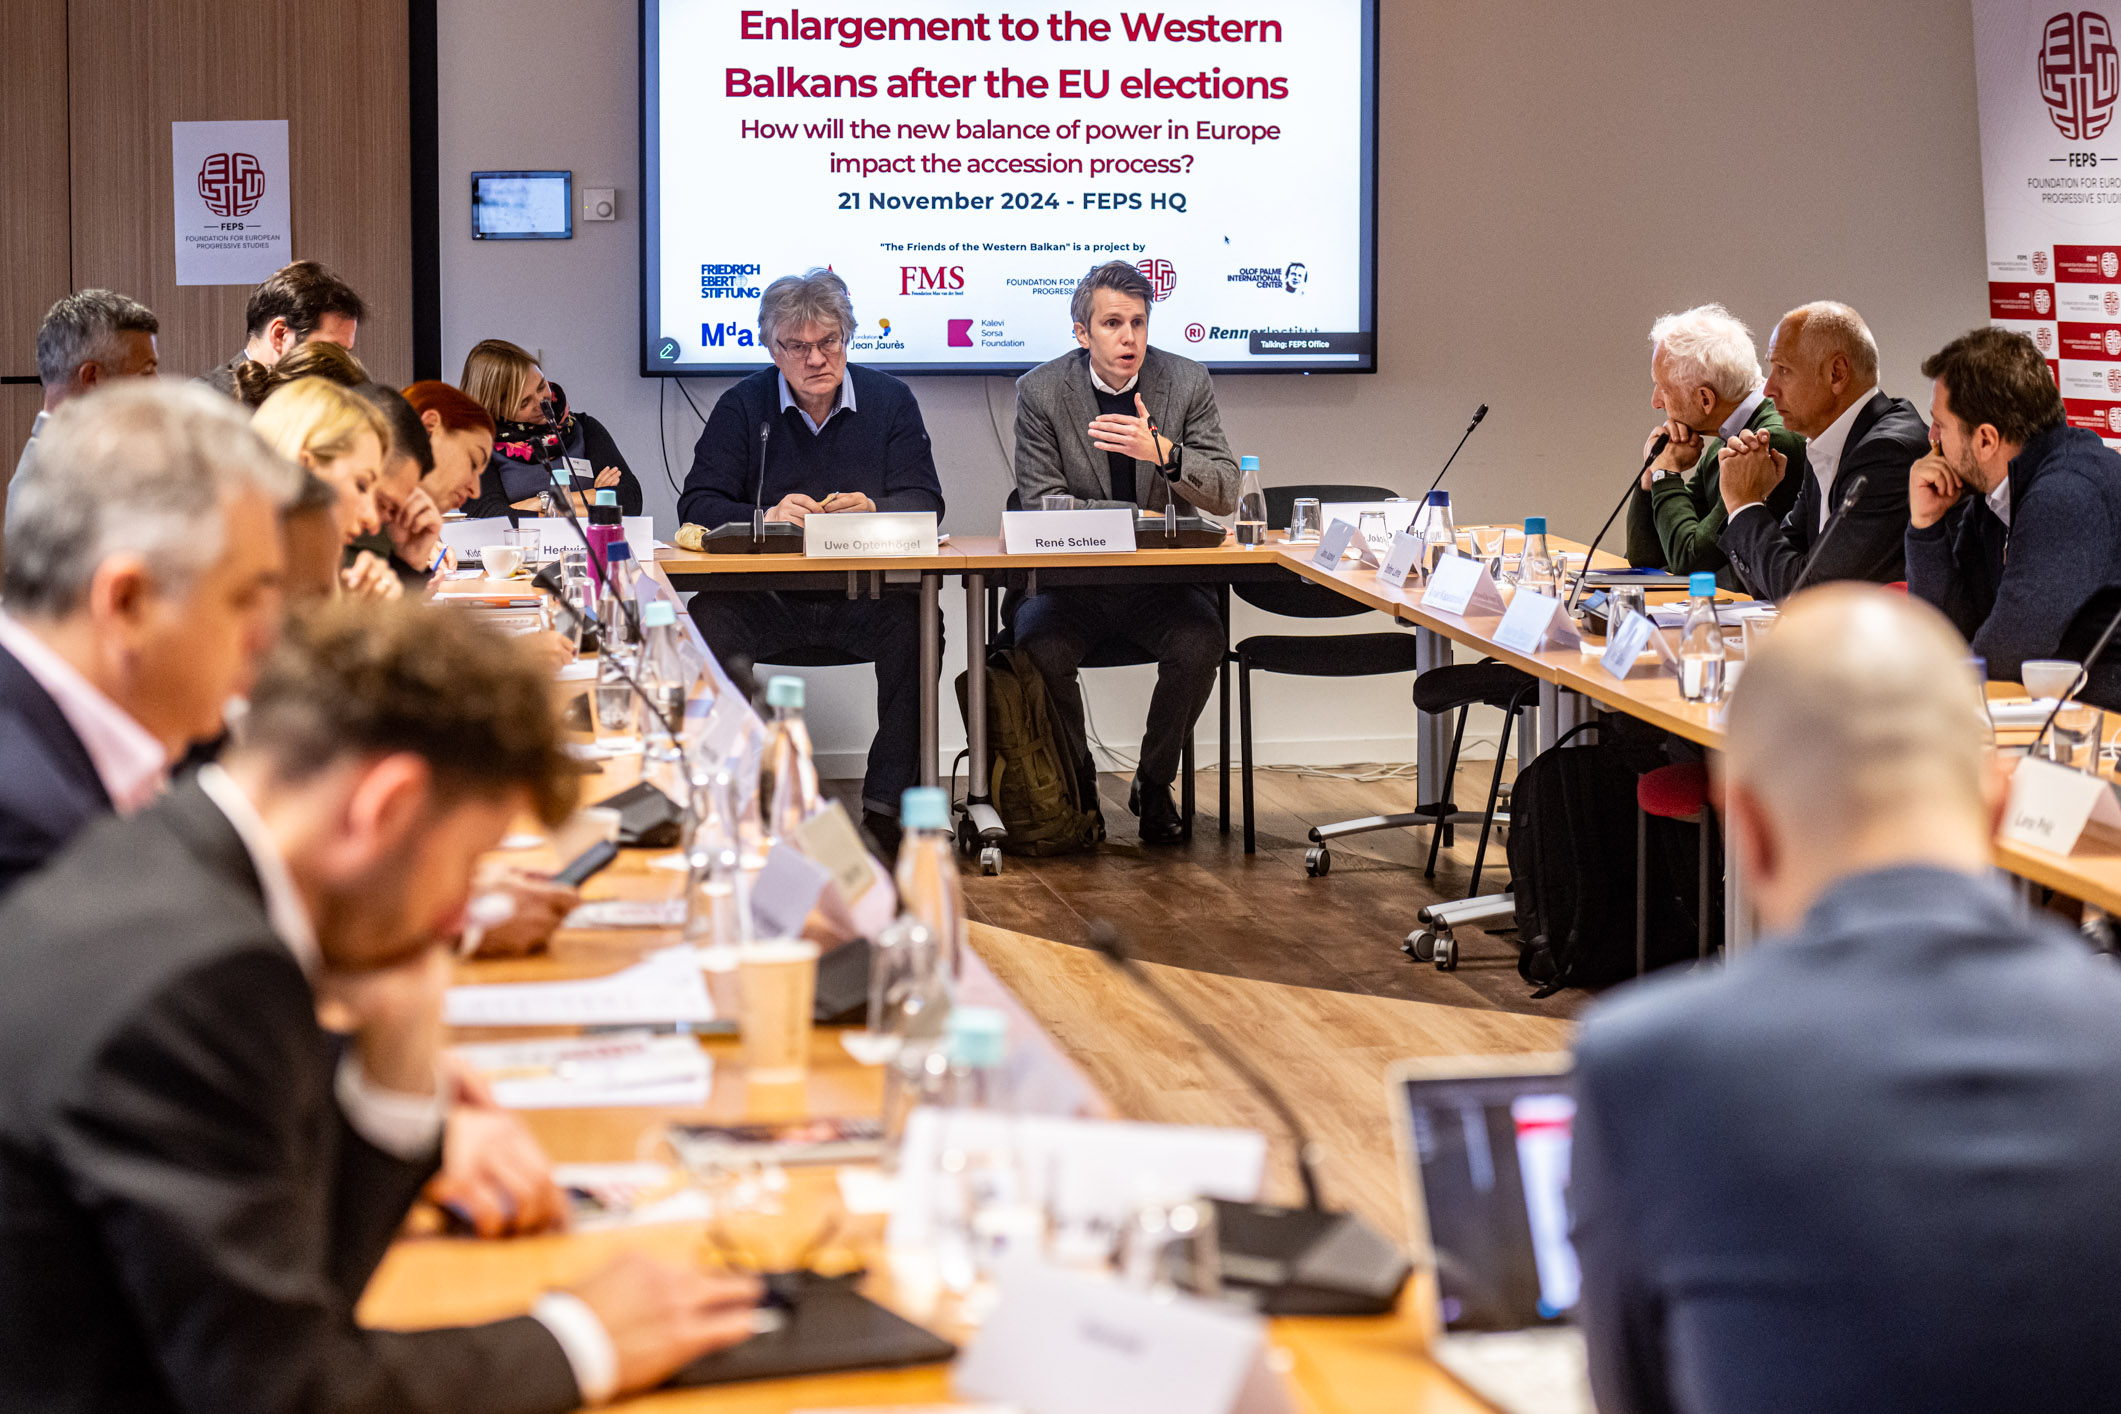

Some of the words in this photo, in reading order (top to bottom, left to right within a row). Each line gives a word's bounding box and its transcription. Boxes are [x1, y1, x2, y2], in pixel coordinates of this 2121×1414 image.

[741, 9, 991, 48] Enlargement
[999, 14, 1039, 41] to
[1047, 11, 1111, 41] the
[1120, 13, 1282, 42] Western
[725, 67, 878, 98] Balkans
[887, 67, 977, 98] after
[984, 67, 1049, 98] the
[1059, 69, 1110, 98] EU
[1120, 67, 1289, 99] elections
[741, 119, 799, 139] How
[803, 118, 844, 139] will
[850, 119, 891, 139] the
[898, 124, 950, 139] new
[956, 119, 1050, 139] balance
[1056, 119, 1081, 139] of
[1086, 124, 1162, 144] power
[1168, 119, 1189, 139] in
[1196, 121, 1281, 145] Europe
[830, 152, 916, 178] impact
[921, 153, 962, 173] the
[967, 152, 1083, 173] accession
[1090, 154, 1194, 178] process?
[2069, 153, 2097, 167] FEPS
[2027, 177, 2079, 189] FOUNDATION
[2081, 177, 2097, 189] FOR
[2100, 177, 2121, 189] EURO
[838, 193, 860, 209] 21
[869, 192, 994, 209] November
[1001, 193, 1059, 209] 2024
[1083, 193, 1142, 209] FEPS
[1150, 193, 1187, 213] HQ
[2042, 193, 2094, 204] PROGRESSIVE
[2097, 193, 2121, 204] STUDI
[220, 223, 244, 231] FEPS
[880, 243, 904, 251] "The
[907, 243, 947, 251] Friends
[949, 243, 960, 251] of
[962, 243, 980, 251] the
[983, 243, 1027, 251] Western
[1030, 243, 1071, 251] Balkan"
[1073, 243, 1082, 251] is
[1093, 243, 1130, 253] project
[1133, 243, 1146, 253] by
[701, 264, 761, 275] FRIEDRICH
[701, 276, 735, 286] EBERT
[899, 265, 965, 296] FMS
[1227, 274, 1282, 282] INTERNATIONAL
[1256, 281, 1283, 289] CENTER
[701, 287, 761, 299] STIFTUNG
[1032, 287, 1077, 295] PROGRESSI
[981, 319, 1004, 327] Kalevi
[981, 329, 1003, 337] Sorsa
[1189, 328, 1201, 338] RI
[851, 340, 873, 350] Jean
[875, 340, 905, 350] Jaurès
[981, 339, 1025, 347] Foundation
[1261, 340, 1287, 349] Talking:
[1288, 340, 1307, 348] FEPS
[1308, 340, 1330, 348] Office
[824, 540, 850, 550] Uwe
[852, 540, 921, 551] Optenhögel
[1035, 538, 1065, 548] René
[1067, 537, 1106, 547] Schlee
